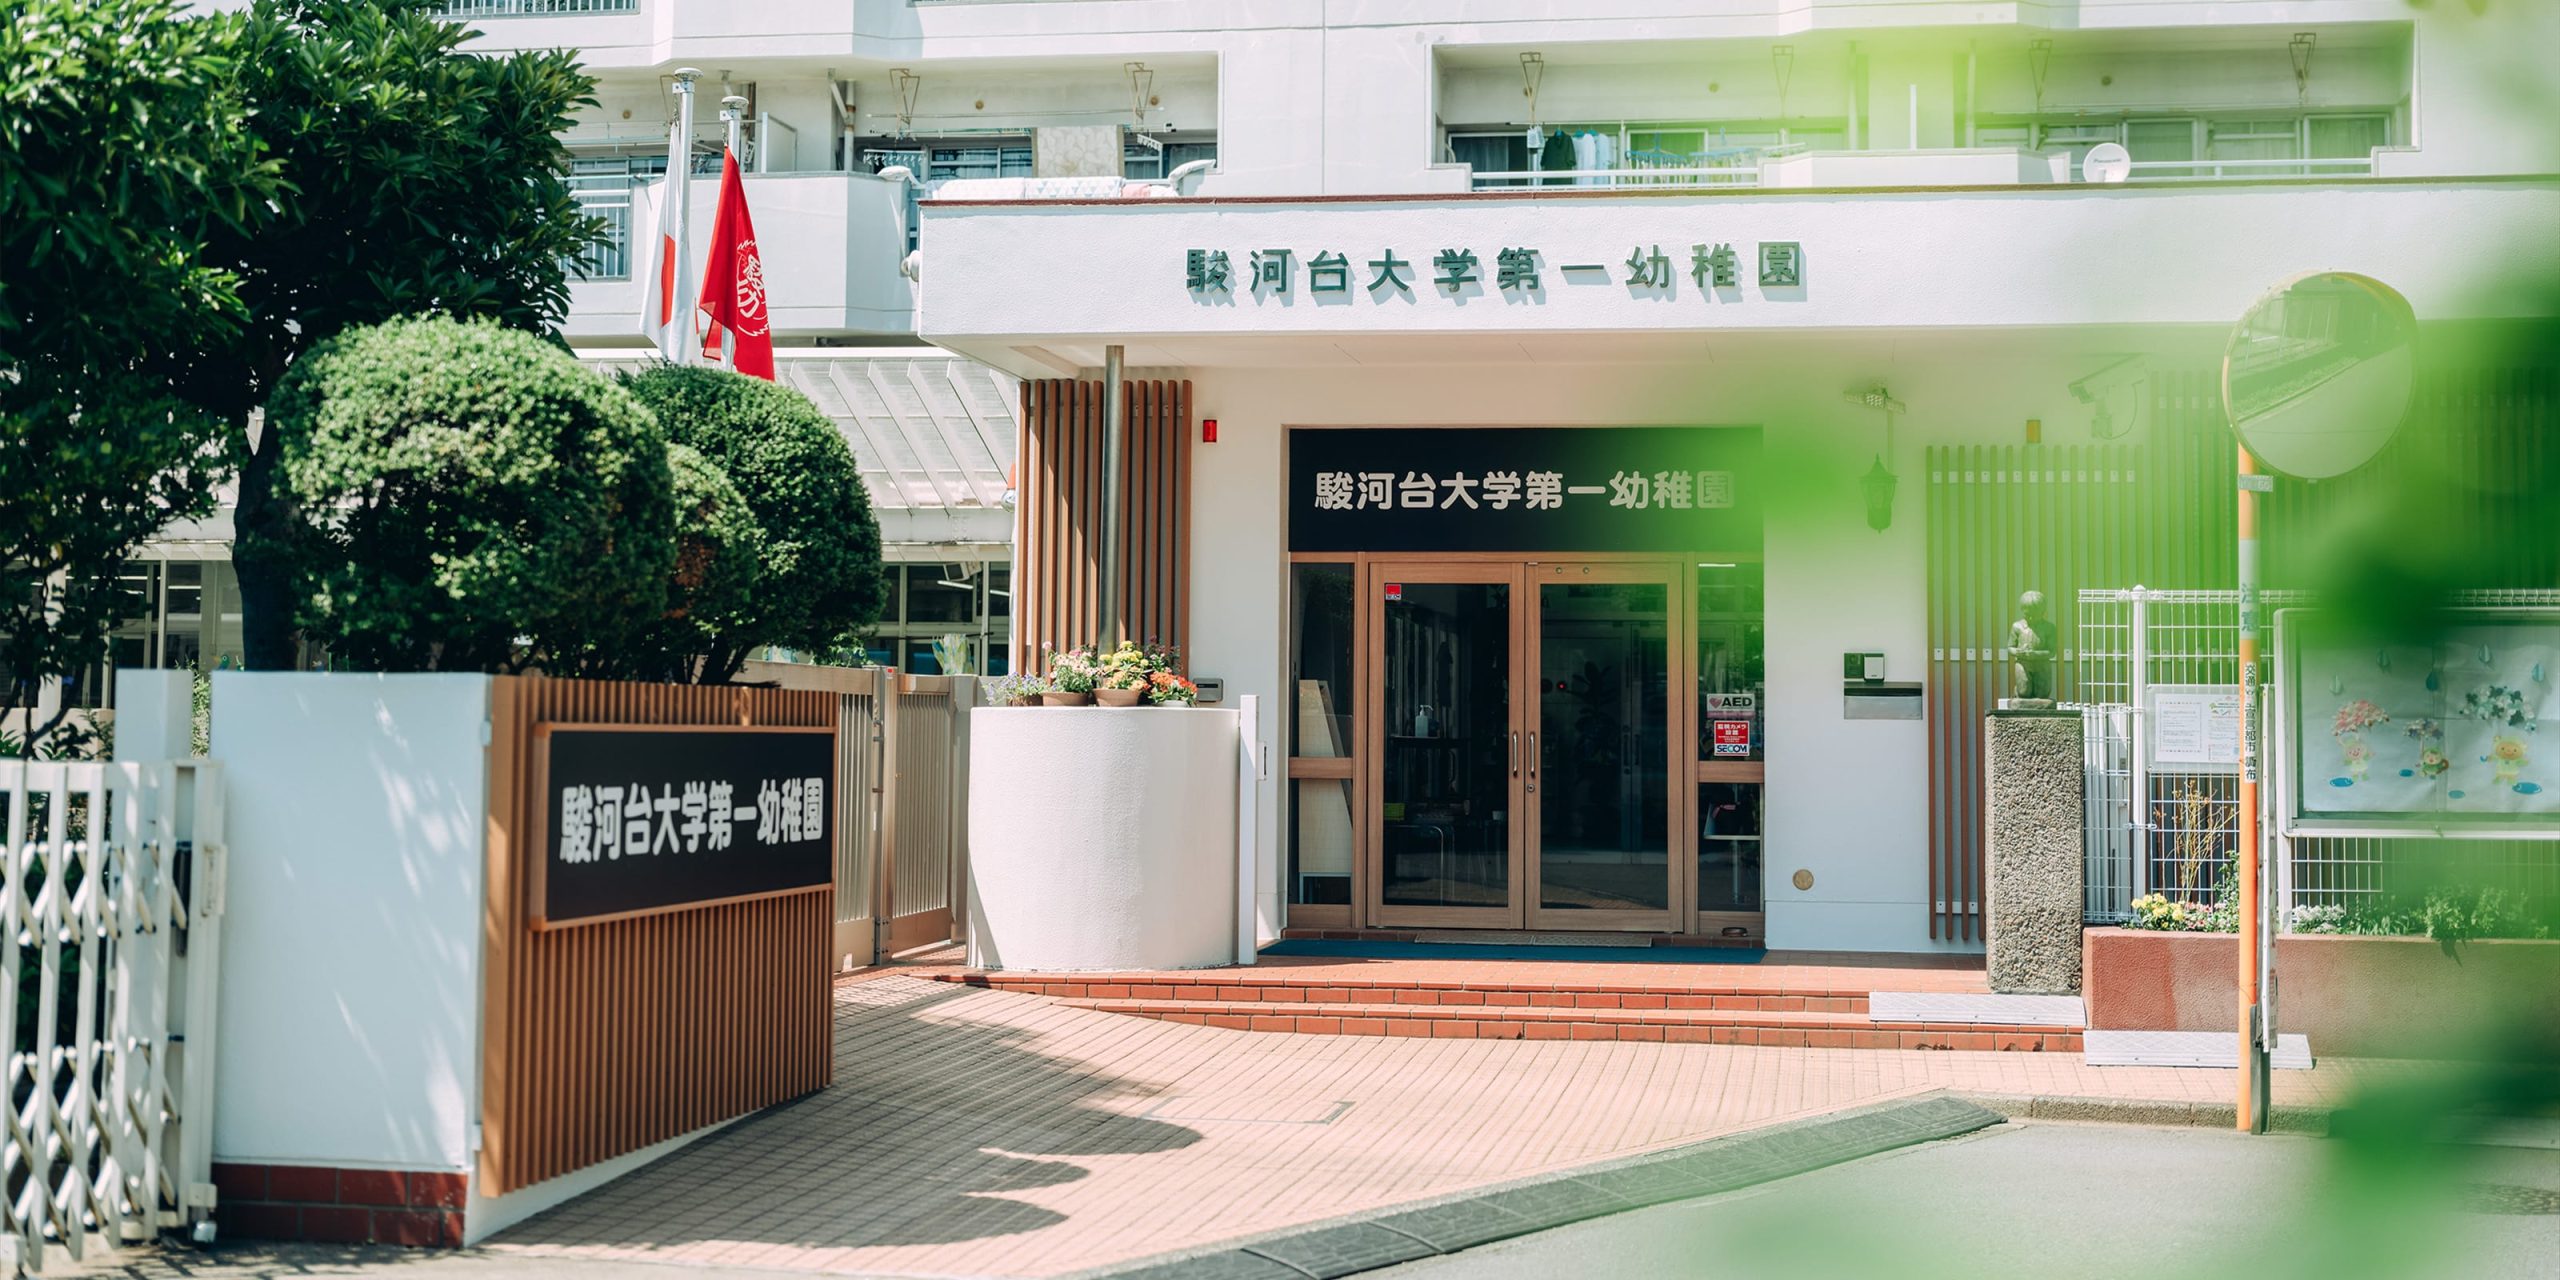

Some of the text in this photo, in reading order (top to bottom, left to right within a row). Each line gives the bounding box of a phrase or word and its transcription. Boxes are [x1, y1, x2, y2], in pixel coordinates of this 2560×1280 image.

[1186, 241, 1801, 294] 駿河台大学第一幼稚園
[1314, 470, 1735, 511] 駿河台大学第一幼稚園
[2241, 583, 2259, 632] 注意
[1722, 697, 1753, 707] AED
[559, 777, 824, 864] 駿河台大学第一幼稚園
